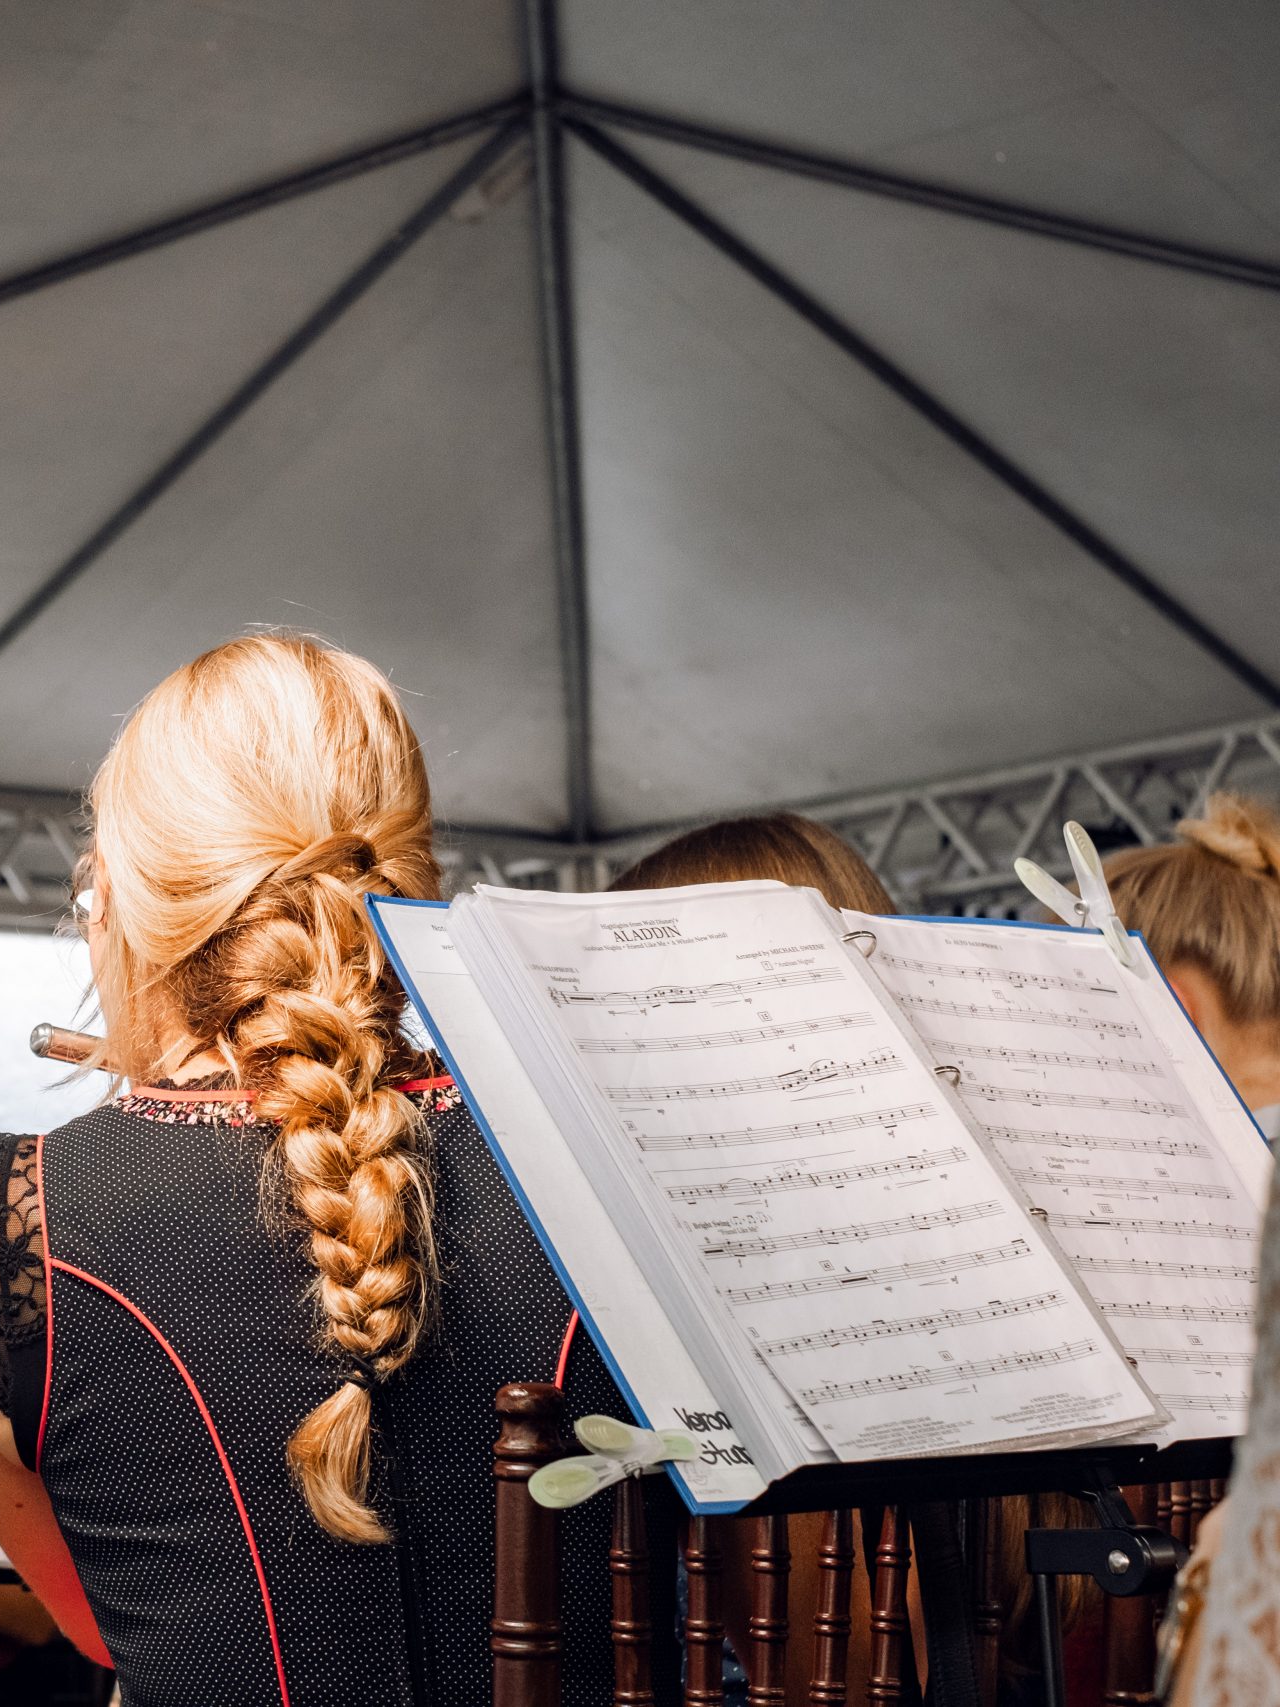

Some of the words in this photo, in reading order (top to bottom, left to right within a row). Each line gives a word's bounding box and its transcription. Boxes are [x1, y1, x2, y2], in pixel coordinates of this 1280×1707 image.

[613, 925, 682, 942] ALADDIN
[735, 950, 763, 960] Arranged
[770, 946, 800, 955] MICHAEL
